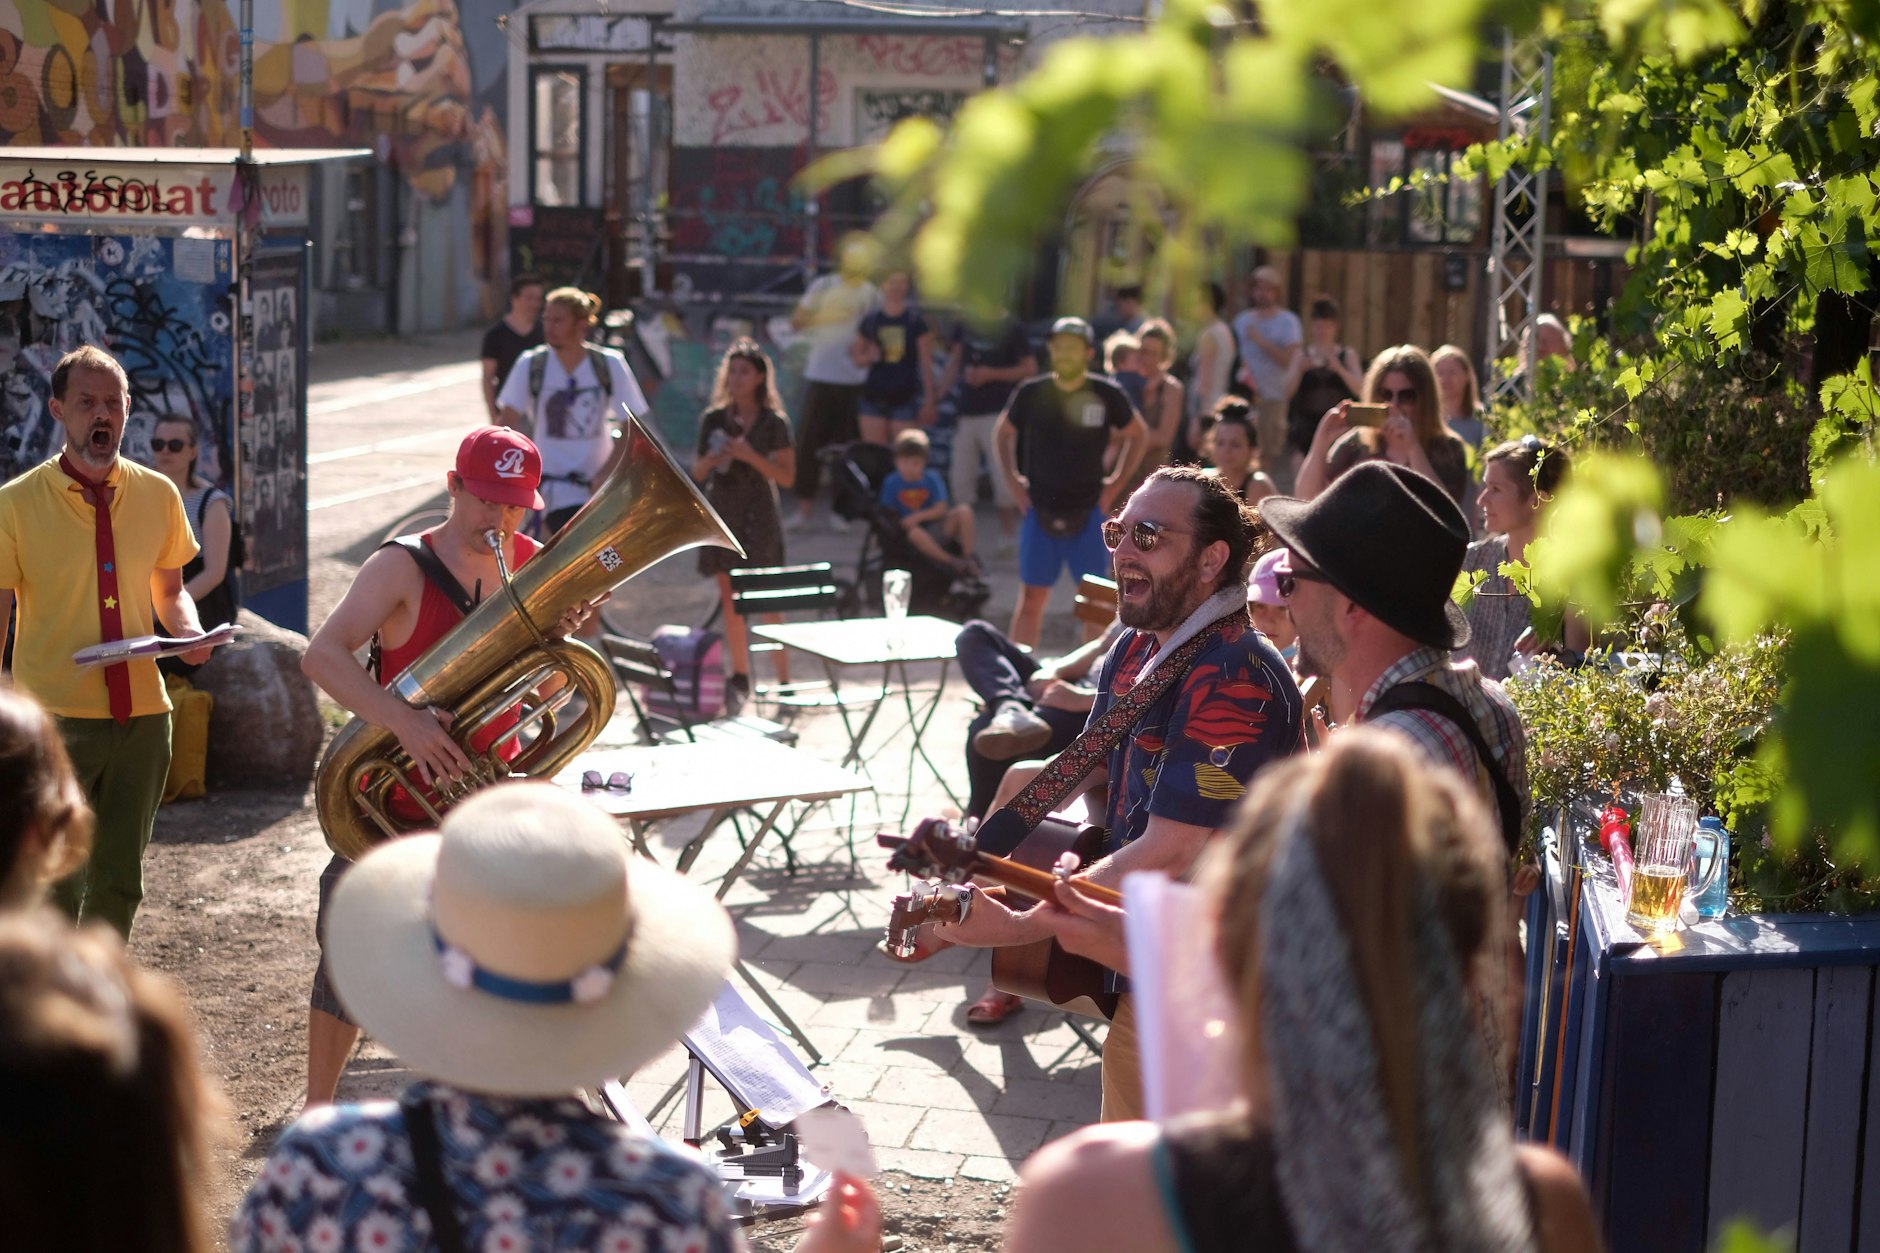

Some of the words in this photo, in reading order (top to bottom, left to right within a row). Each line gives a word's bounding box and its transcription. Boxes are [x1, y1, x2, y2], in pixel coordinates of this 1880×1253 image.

[1, 176, 217, 217] automat
[494, 448, 525, 474] R
[596, 549, 616, 572] NZS
[603, 545, 624, 567] FCK
